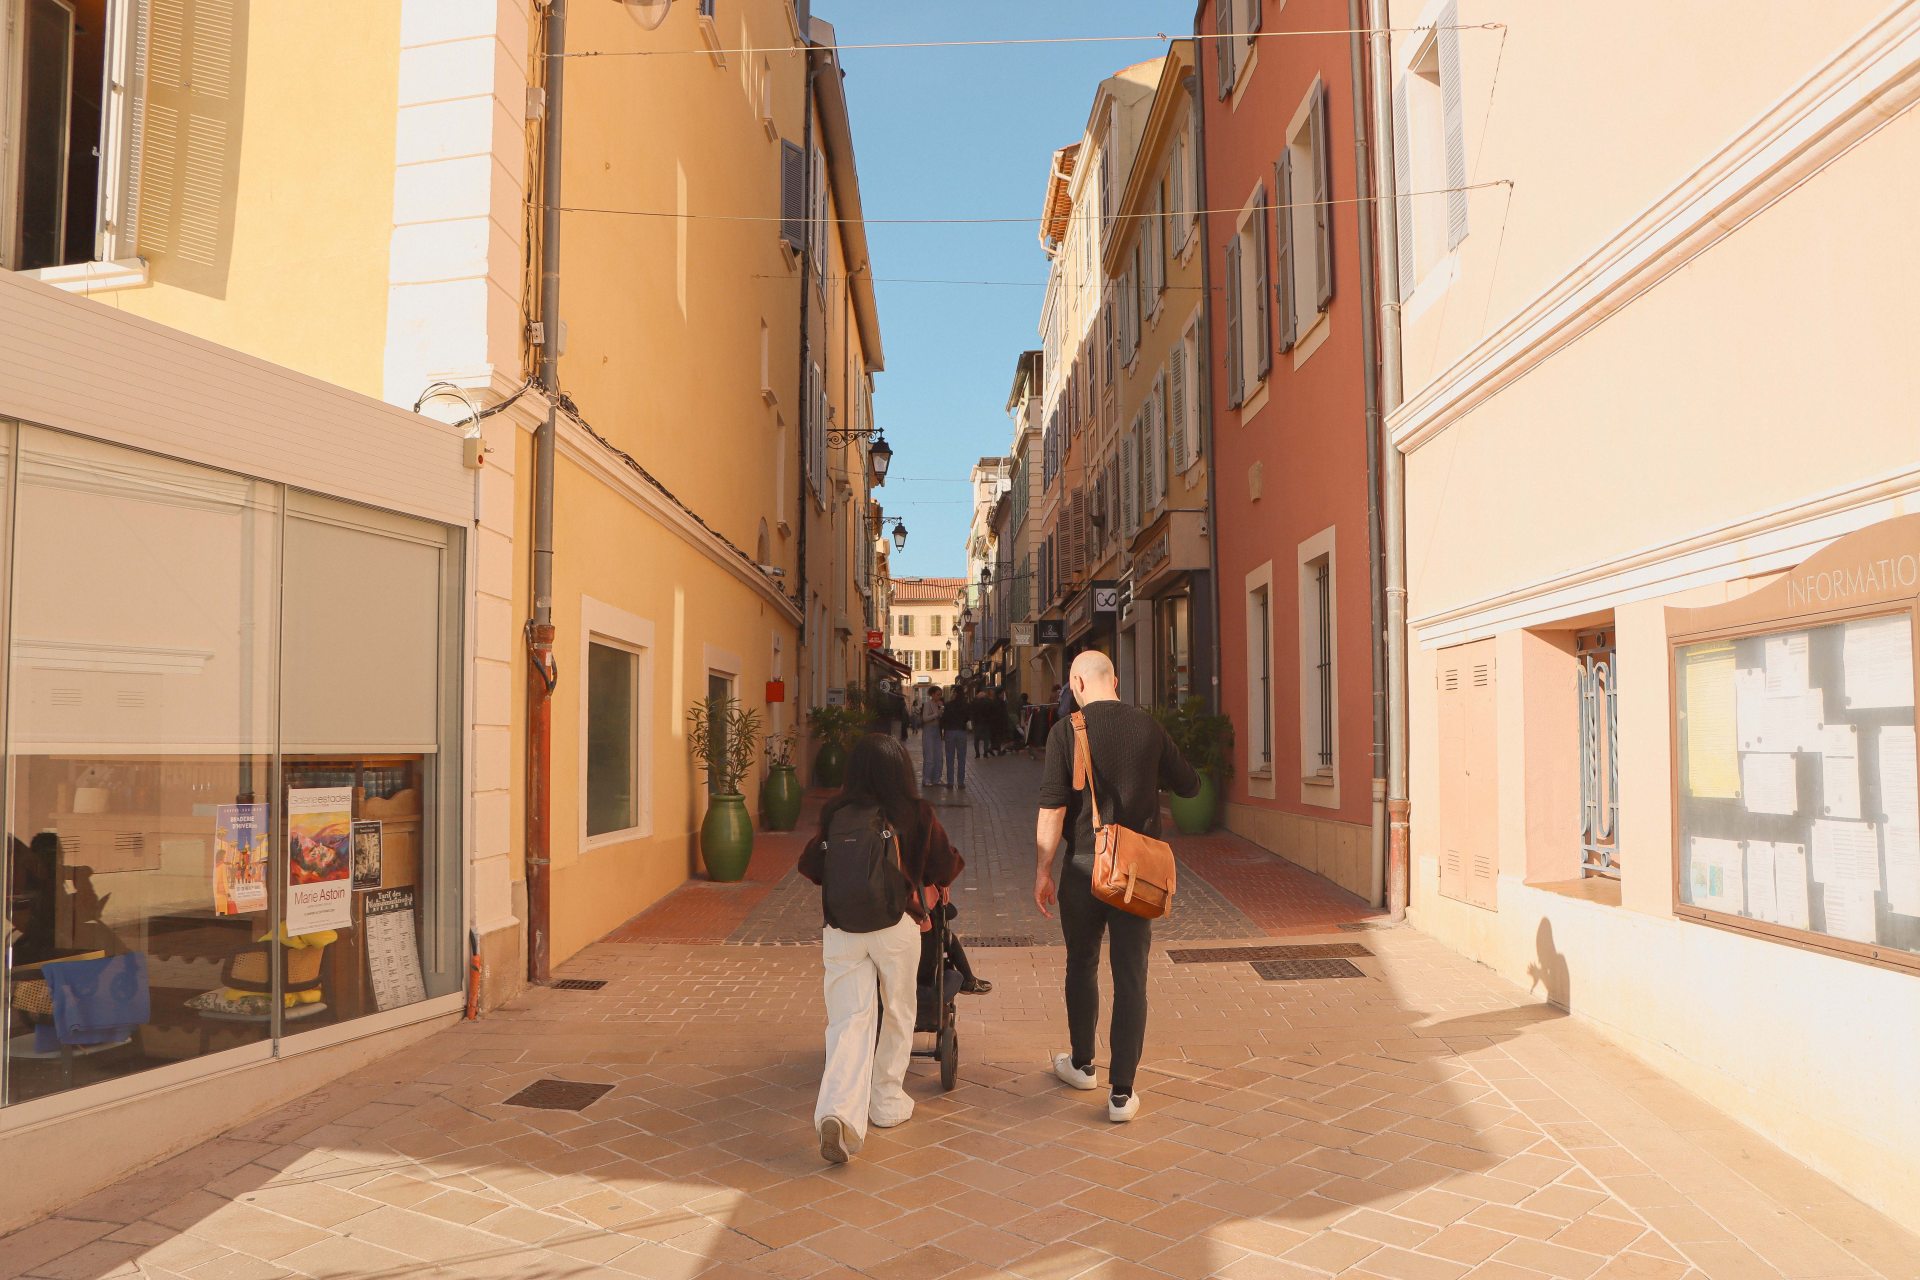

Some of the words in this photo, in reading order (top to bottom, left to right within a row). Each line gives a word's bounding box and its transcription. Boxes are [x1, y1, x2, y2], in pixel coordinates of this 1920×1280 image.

[1786, 552, 1920, 608] INFORMATIO
[294, 890, 318, 905] Marie
[319, 888, 345, 901] Astoin
[378, 890, 391, 901] Tarif
[391, 890, 402, 898] des
